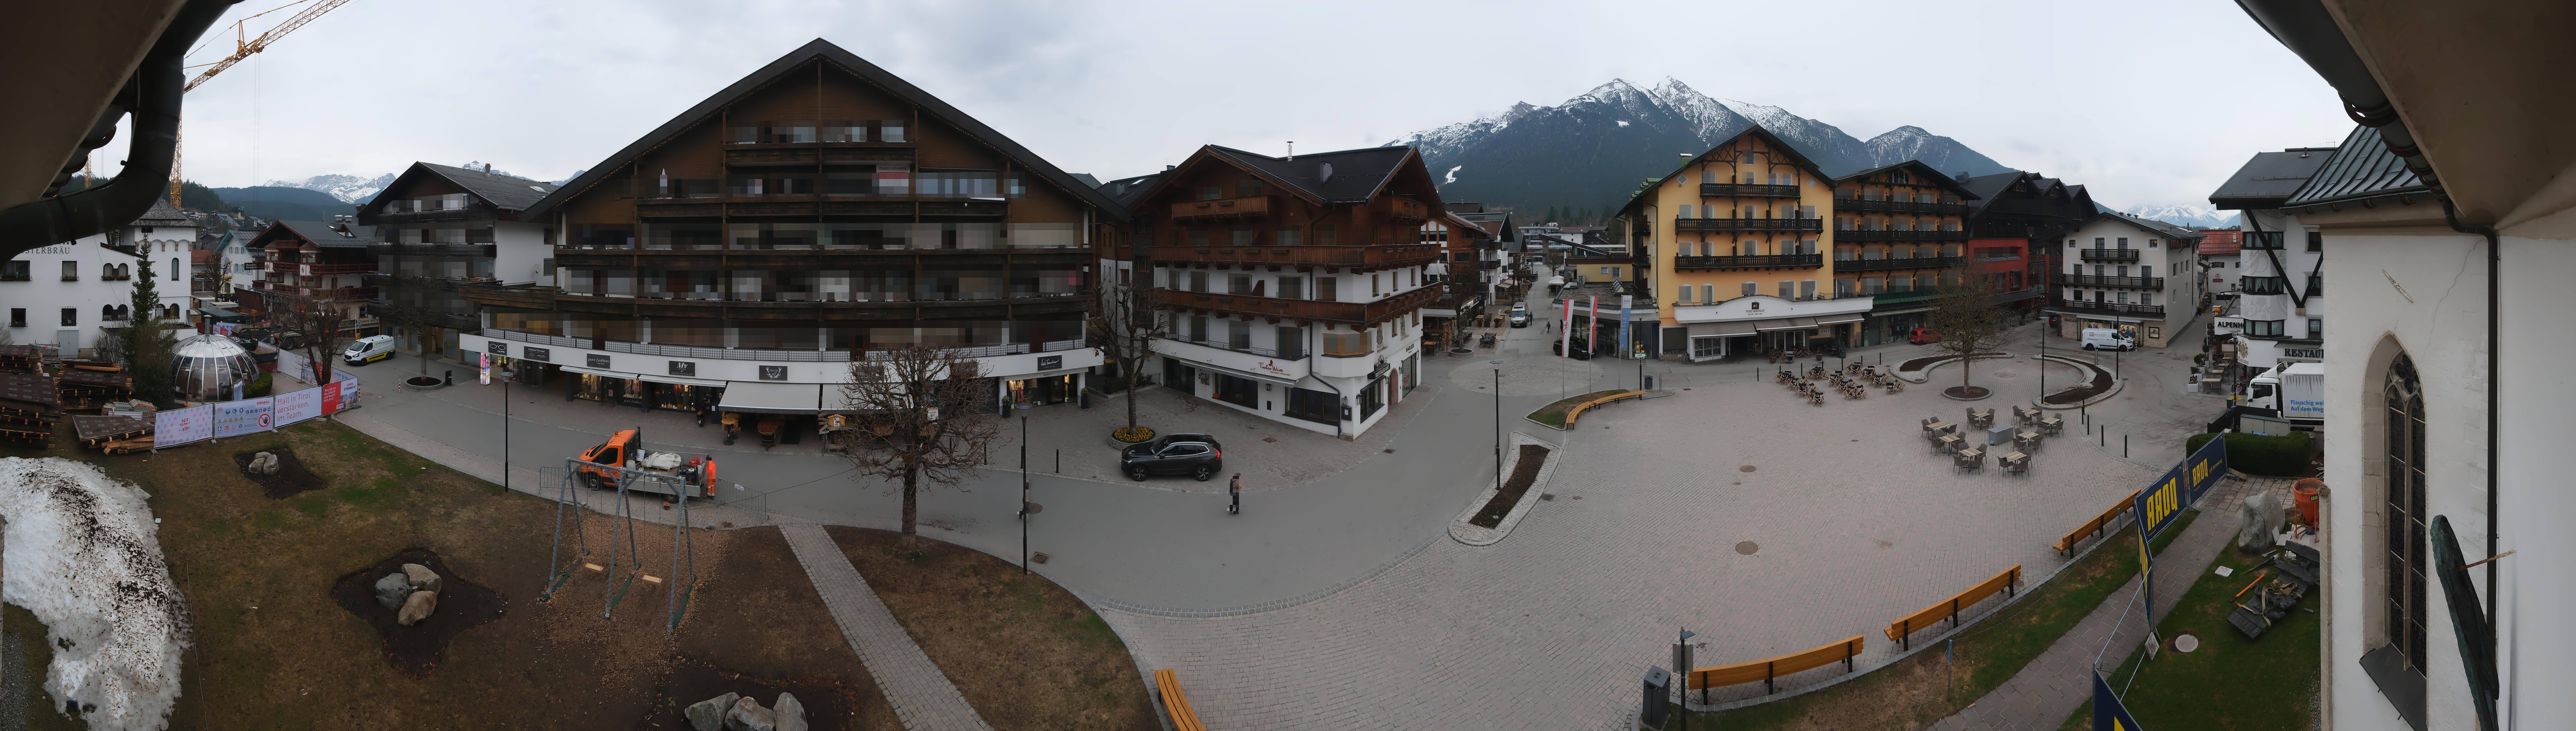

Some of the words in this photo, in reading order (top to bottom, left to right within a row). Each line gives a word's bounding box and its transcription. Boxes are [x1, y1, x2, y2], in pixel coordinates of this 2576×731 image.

[1406, 344, 1414, 352] SAILER
[2238, 356, 2249, 365] Kaltschmid
[676, 362, 688, 372] My
[1375, 365, 1389, 378] RESTAURANT
[278, 397, 289, 405] Hall
[298, 392, 310, 400] Tirol
[277, 402, 309, 413] verstärken.
